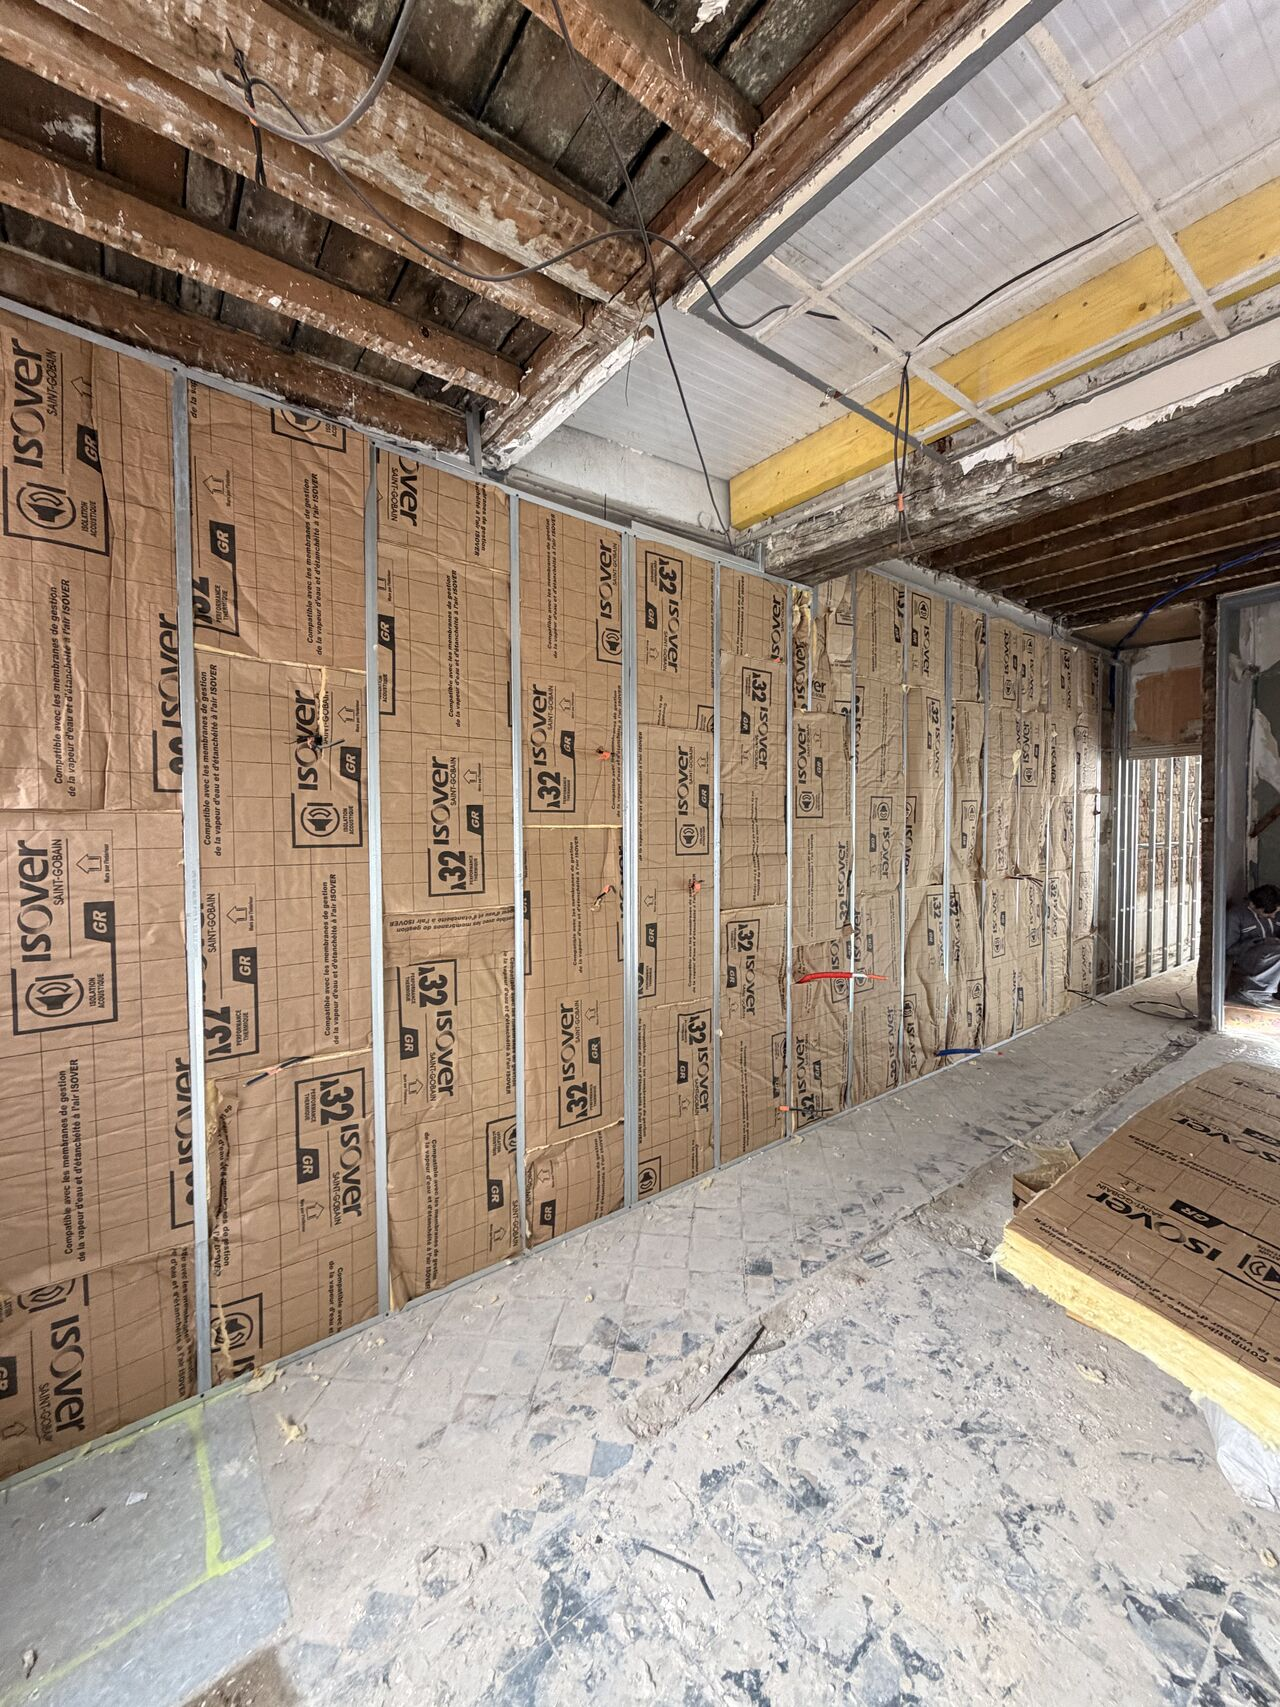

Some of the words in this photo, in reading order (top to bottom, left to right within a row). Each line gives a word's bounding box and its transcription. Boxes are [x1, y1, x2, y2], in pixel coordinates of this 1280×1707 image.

[46, 348, 57, 416] SAINT-GOBAIN
[85, 434, 98, 461] GR
[215, 530, 229, 553] GR
[49, 586, 59, 621] gestion
[61, 579, 70, 615] ISOVER
[62, 617, 70, 634] l'air
[648, 609, 655, 624] GR
[50, 624, 58, 634] de
[381, 622, 391, 640] GR
[50, 638, 60, 691] membranes
[63, 645, 72, 701] d'étanchéité
[199, 671, 208, 701] gestion
[209, 664, 217, 695] ISOVER
[52, 694, 60, 707] les
[65, 704, 72, 713] et
[200, 704, 207, 713] de
[65, 716, 73, 740] d'eau
[742, 719, 749, 731] GR
[200, 715, 208, 762] membranes
[210, 722, 219, 770] d'étanchéité
[564, 736, 572, 752] GR
[53, 734, 62, 783] Compatible
[68, 743, 76, 772] vapeur
[346, 754, 356, 774] GR
[67, 775, 75, 783] la
[213, 772, 219, 780] et
[67, 785, 76, 796] de
[702, 789, 707, 803] GR
[203, 799, 211, 845] Compatible
[214, 807, 223, 834] vapeur
[471, 811, 479, 827] GR
[214, 846, 221, 856] de
[51, 839, 64, 905] SAINT-GOBAIN
[92, 911, 108, 933] GR
[207, 893, 216, 953] SAINT-GOBAIN
[649, 928, 655, 944] GR
[240, 956, 251, 976] GR
[730, 970, 735, 983] GR
[97, 973, 105, 1008] ACOUSTIQUE
[404, 1034, 414, 1052] GR
[592, 1043, 599, 1059] GR
[69, 1059, 78, 1092] ISOVER
[679, 1065, 686, 1079] GR
[58, 1070, 68, 1102] gestion
[59, 1105, 67, 1115] de
[71, 1095, 79, 1110] l'air
[60, 1117, 69, 1167] membranes
[71, 1121, 82, 1173] d'étanchéité
[1170, 1117, 1280, 1165] SOver
[302, 1156, 312, 1174] GR
[62, 1170, 70, 1182] les
[75, 1176, 82, 1184] et
[74, 1186, 83, 1209] d'eau
[332, 1172, 342, 1226] SAINT-GOBAIN
[491, 1186, 499, 1203] GR
[1096, 1183, 1164, 1218] SAINT-GOBAIN
[544, 1206, 552, 1220] GR
[1181, 1207, 1210, 1222] GR
[63, 1207, 74, 1254] Compatible
[77, 1211, 87, 1239] vapeur
[77, 1252, 85, 1261] de
[1088, 1255, 1147, 1290] membranes
[1167, 1303, 1196, 1320] avec
[1197, 1321, 1267, 1363] Compatible
